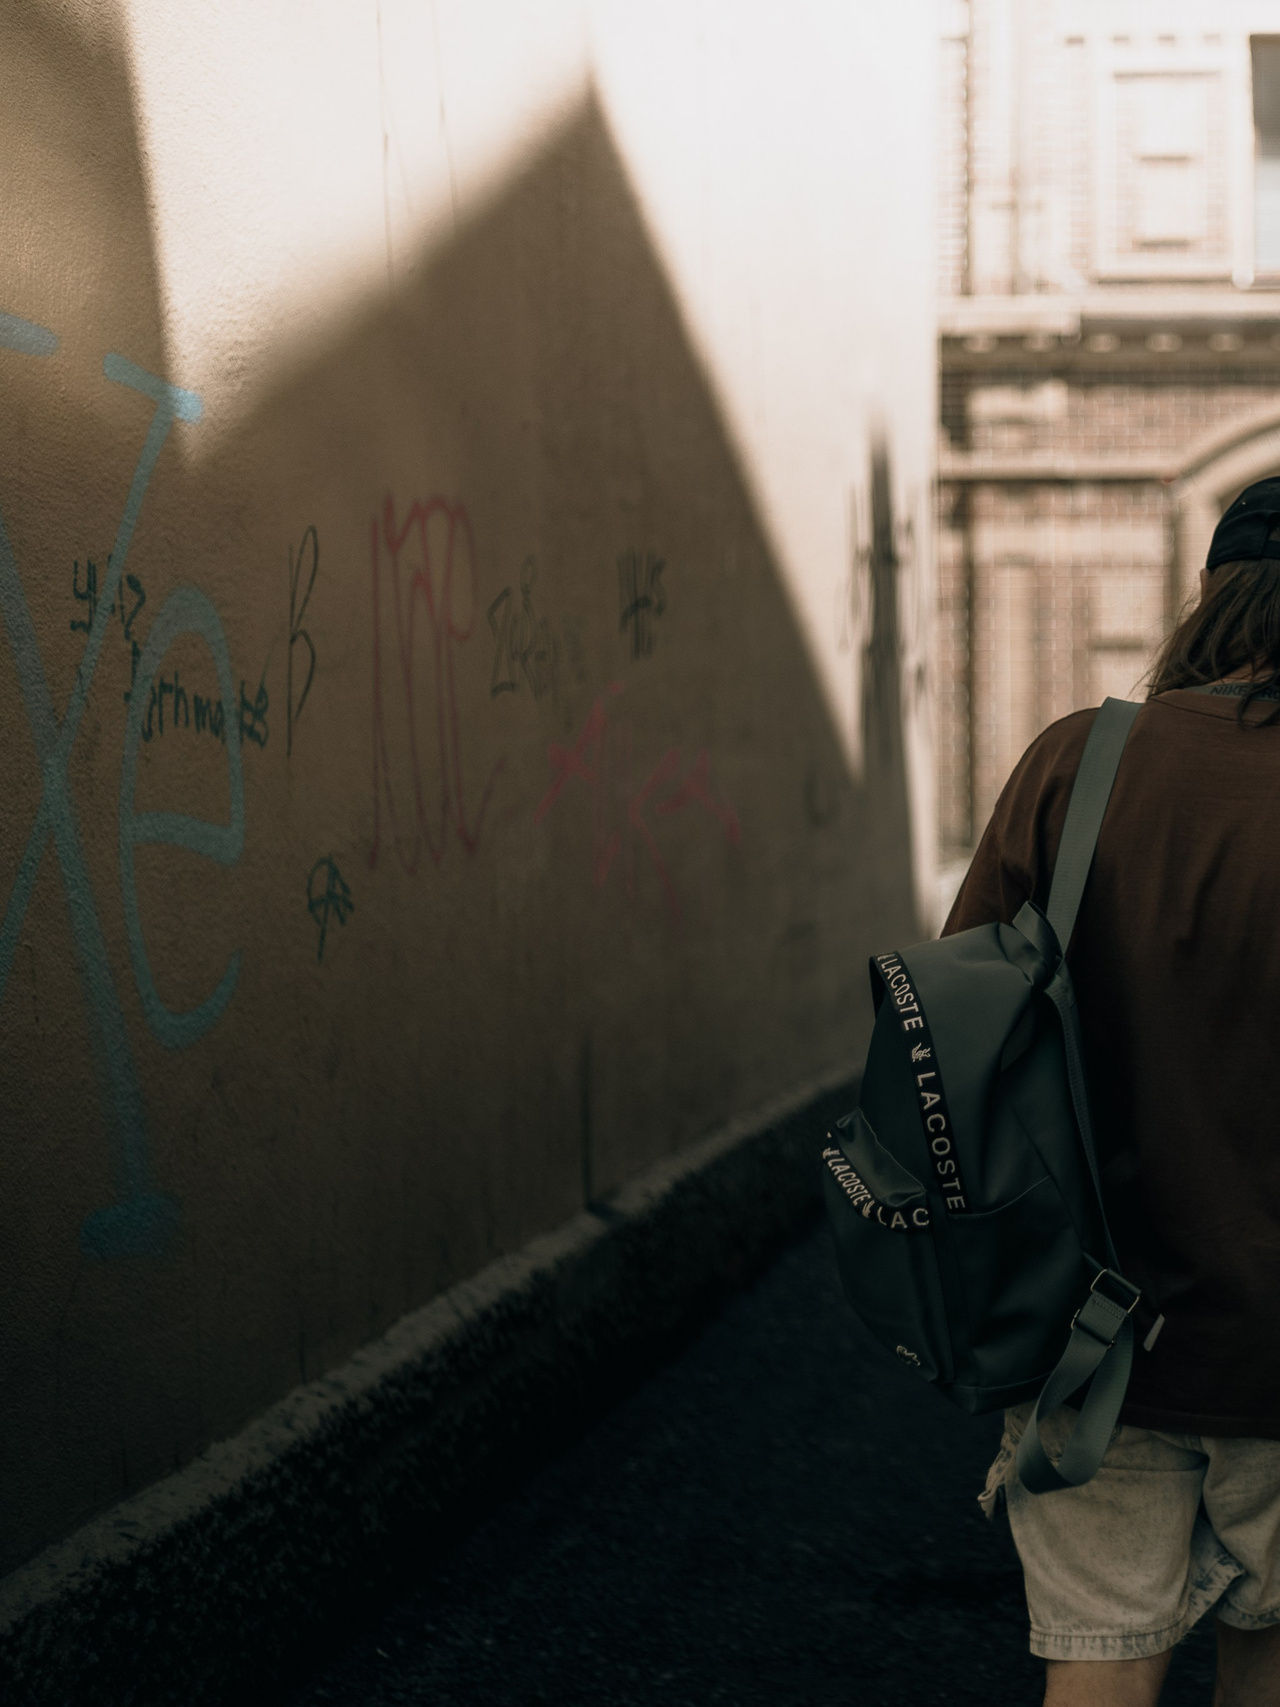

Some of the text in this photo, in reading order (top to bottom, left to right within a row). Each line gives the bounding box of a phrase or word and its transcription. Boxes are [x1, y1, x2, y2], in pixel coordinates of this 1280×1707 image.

[1209, 684, 1249, 697] NIKE
[880, 957, 967, 1211] LACOSTE LACOSTE
[826, 1157, 872, 1207] LACOSTE
